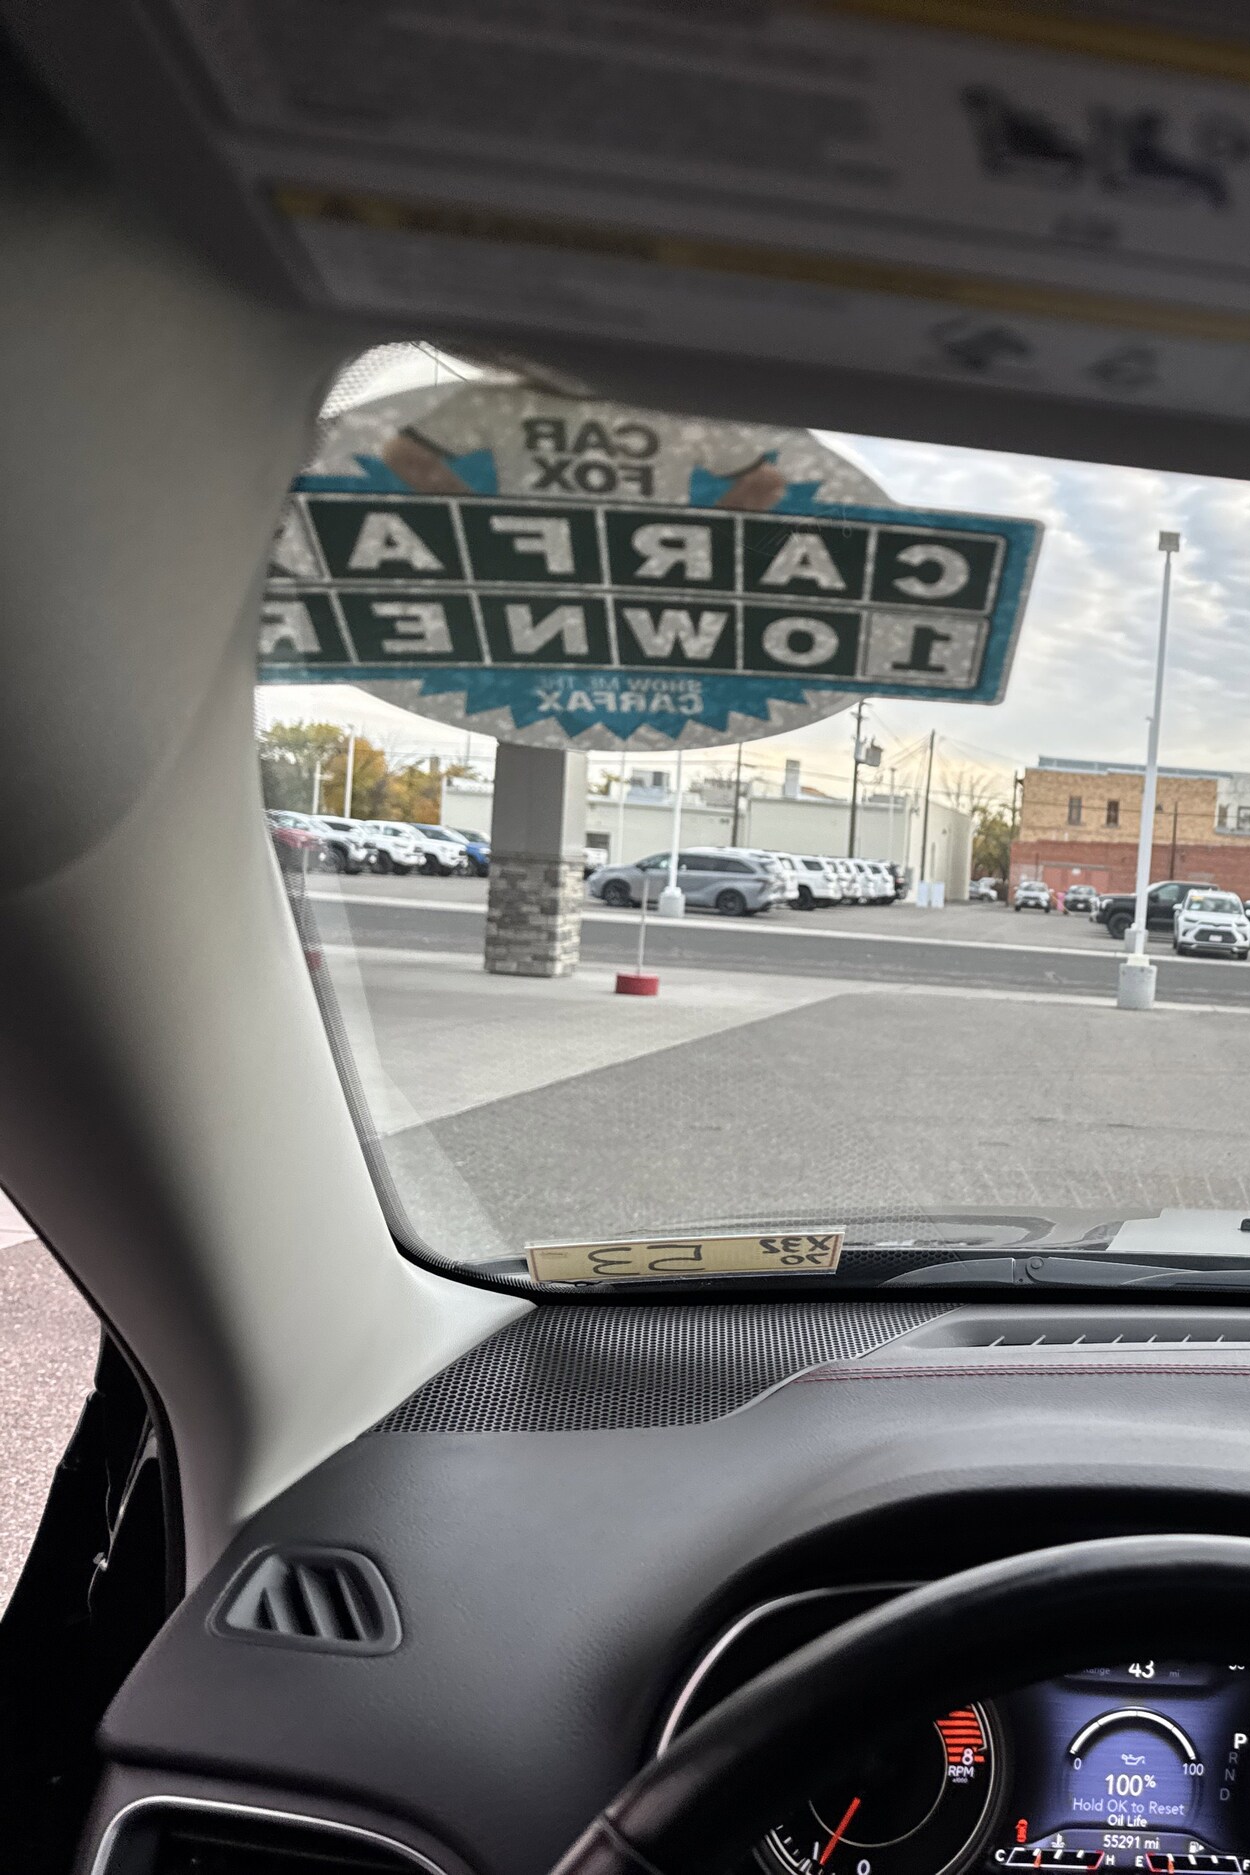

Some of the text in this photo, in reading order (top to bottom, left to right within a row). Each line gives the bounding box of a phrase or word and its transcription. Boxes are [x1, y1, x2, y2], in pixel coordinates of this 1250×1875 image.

[1083, 1666, 1110, 1676] ange
[1128, 1660, 1155, 1678] 43
[1234, 1733, 1247, 1749] P
[962, 1748, 974, 1766] 8
[1073, 1758, 1082, 1771] 0
[948, 1765, 975, 1778] RPM
[1182, 1763, 1204, 1776] 100
[1105, 1773, 1156, 1797] 100%
[1220, 1787, 1230, 1801] D
[1073, 1797, 1185, 1816] Hold OK to Reset
[1107, 1813, 1148, 1828] Oil Life
[1103, 1834, 1160, 1850] 55291 mi
[994, 1849, 1006, 1862] C
[1105, 1854, 1115, 1866] H
[1135, 1855, 1144, 1868] E
[856, 1859, 871, 1875] 0
